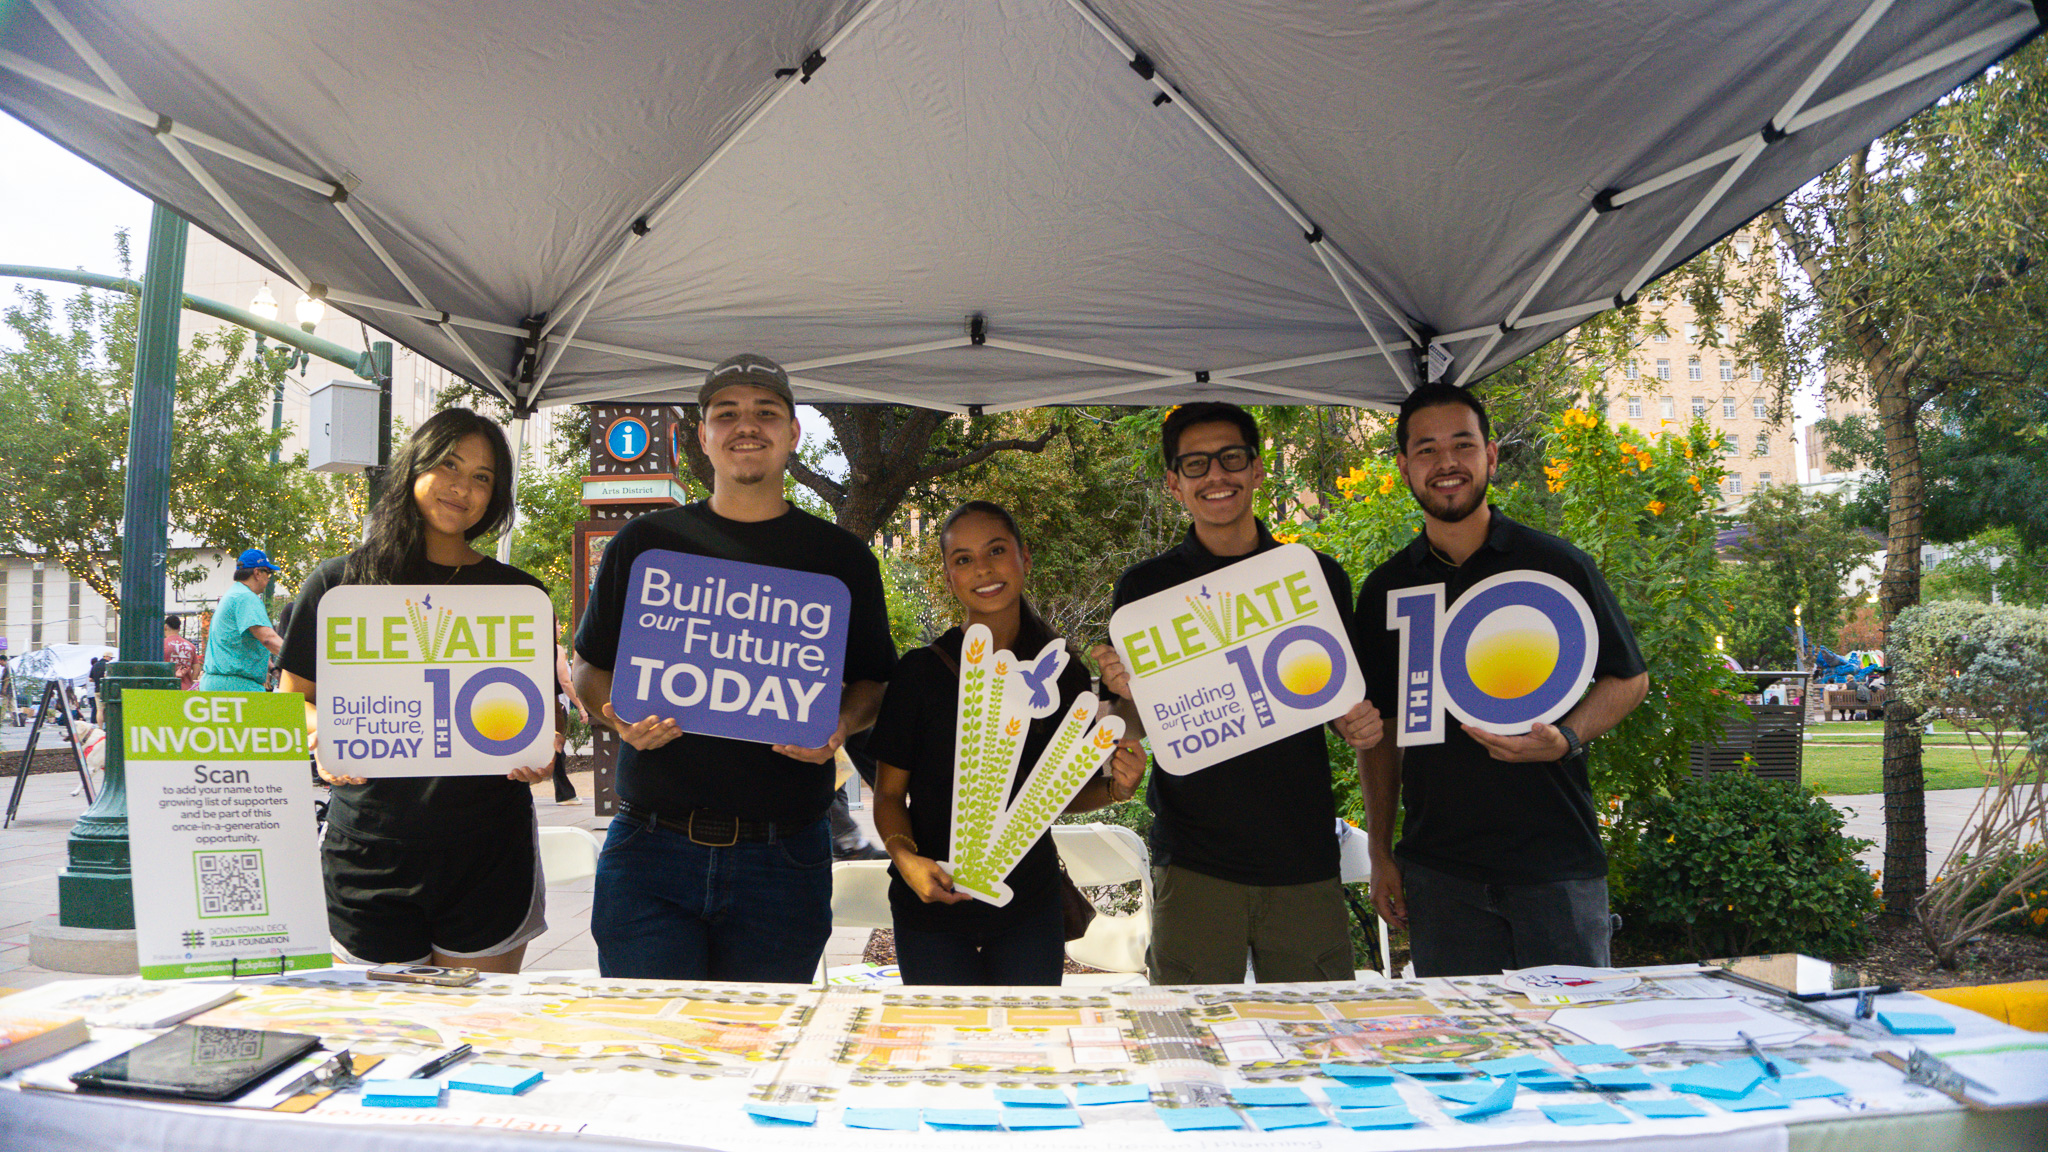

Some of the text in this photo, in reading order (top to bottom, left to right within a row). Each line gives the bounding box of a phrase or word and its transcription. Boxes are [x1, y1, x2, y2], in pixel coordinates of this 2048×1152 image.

[601, 486, 653, 495] Arts District
[640, 567, 832, 640] Building
[326, 602, 536, 662] ELEVATE
[1122, 570, 1319, 676] ELEVATE
[638, 612, 830, 677] our Future,
[1396, 580, 1588, 734] 10
[630, 656, 827, 723] TODAY
[1224, 624, 1347, 729] 10
[183, 696, 248, 723] GET
[332, 695, 422, 718] Building
[424, 667, 545, 758] 10
[1153, 682, 1236, 722] Building
[1251, 690, 1273, 727] THE
[1409, 670, 1429, 728] THE
[333, 716, 424, 736] our Future,
[1161, 701, 1245, 732] our Future,
[130, 726, 303, 753] INVOLVED!
[333, 738, 423, 760] TODAY
[436, 718, 449, 755] THE
[1167, 715, 1247, 760] TODAY
[194, 765, 250, 784] Scan
[159, 797, 288, 809] growing list of supporters
[163, 785, 283, 797] to add your name to the
[171, 821, 280, 833] once-in-a-generation
[180, 808, 272, 821] and be part of this
[195, 833, 260, 844] opportunity.
[208, 923, 288, 935] DOWNTOWN DECK
[210, 935, 290, 948] PLAZA FOUNDATION
[184, 960, 295, 974] downtowneckplaza.rg
[472, 1116, 562, 1133] Plan
